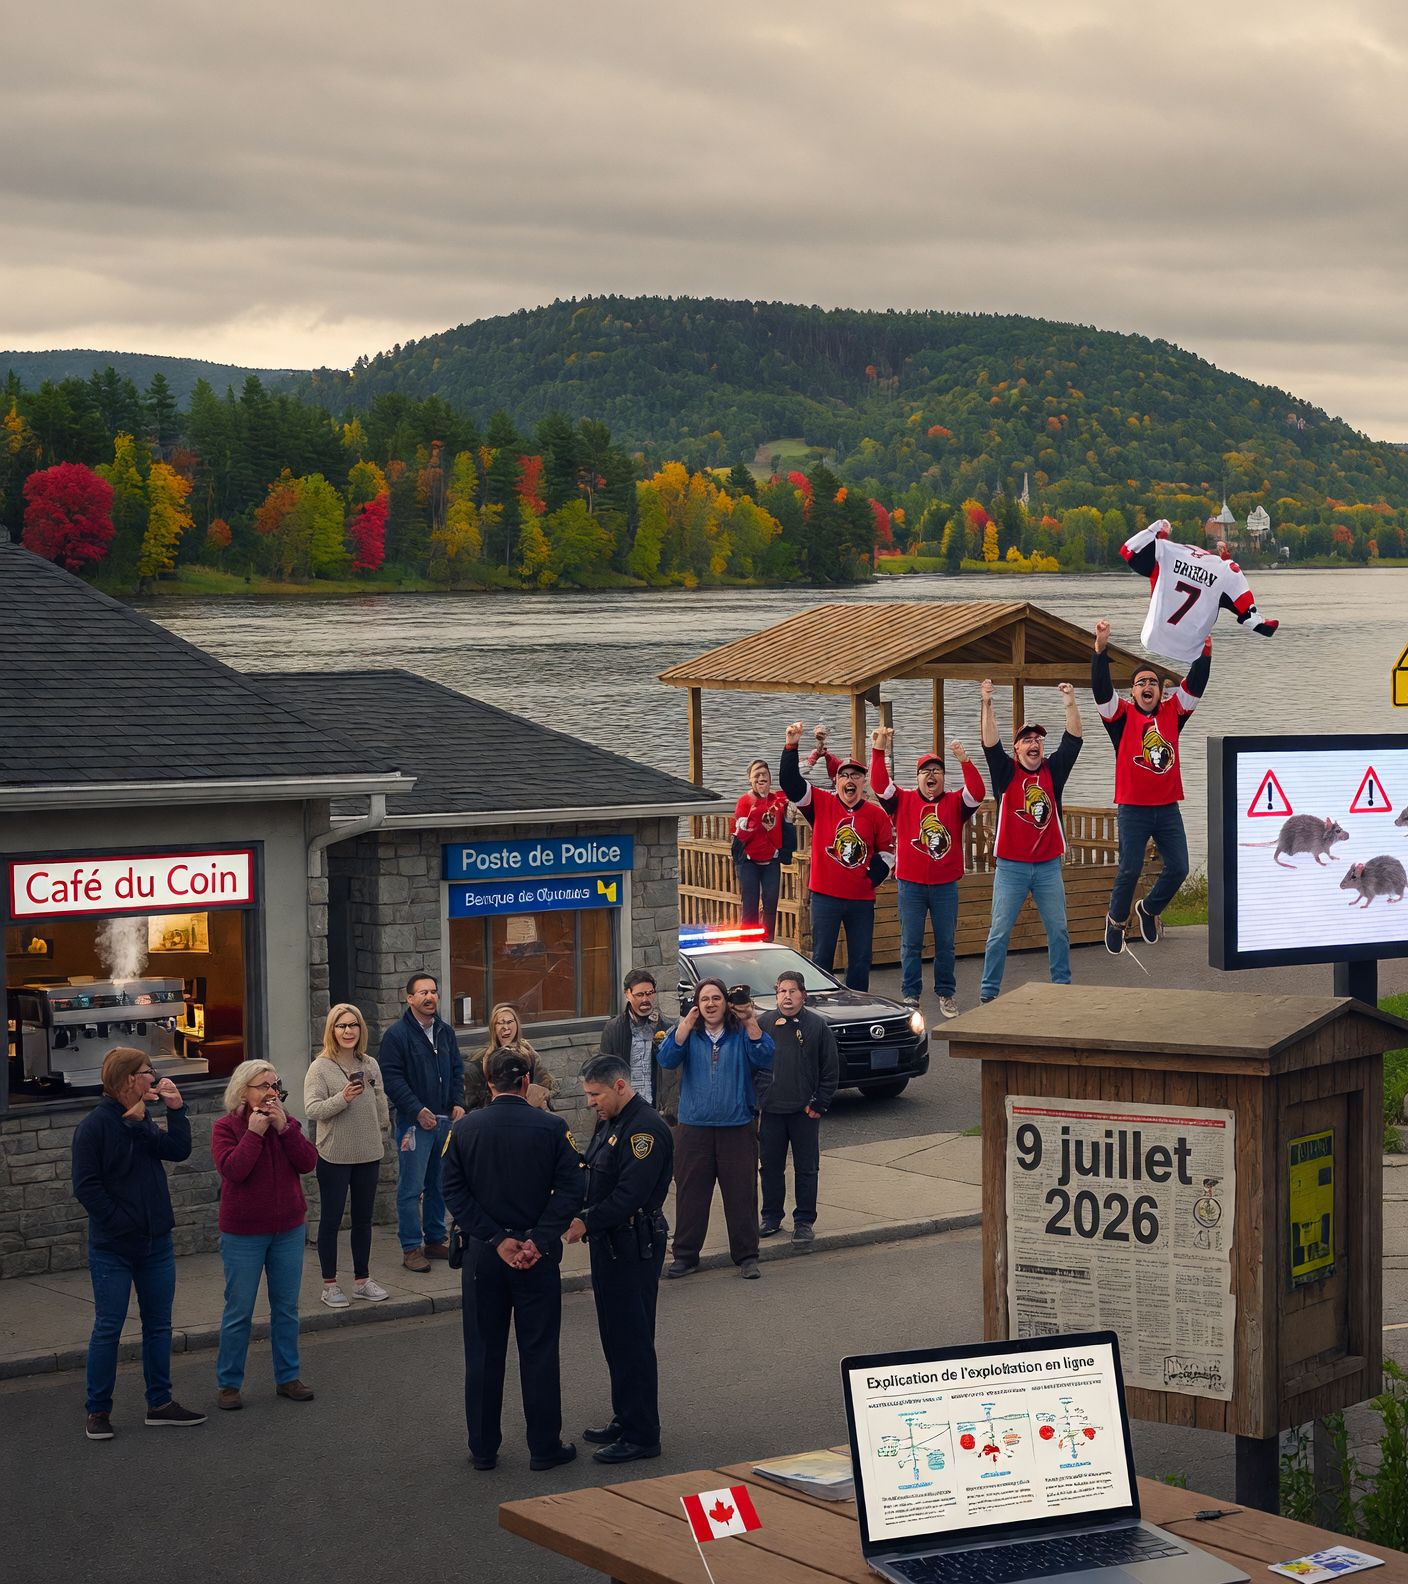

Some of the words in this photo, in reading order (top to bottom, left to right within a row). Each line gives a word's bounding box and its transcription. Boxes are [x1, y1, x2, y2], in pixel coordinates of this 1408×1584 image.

[1166, 580, 1202, 626] 7
[462, 848, 521, 872] Poste
[528, 844, 554, 867] de
[561, 841, 621, 864] Police
[26, 868, 102, 904] Café
[114, 866, 154, 899] du
[167, 862, 237, 896] Coin
[518, 890, 534, 902] de
[1016, 1123, 1043, 1171] 9
[1058, 1125, 1193, 1187] juillet
[1045, 1188, 1159, 1245] 2026
[866, 1370, 939, 1391] Explication
[941, 1368, 958, 1382] de
[1045, 1360, 1061, 1371] en
[1063, 1356, 1095, 1372] ligne
